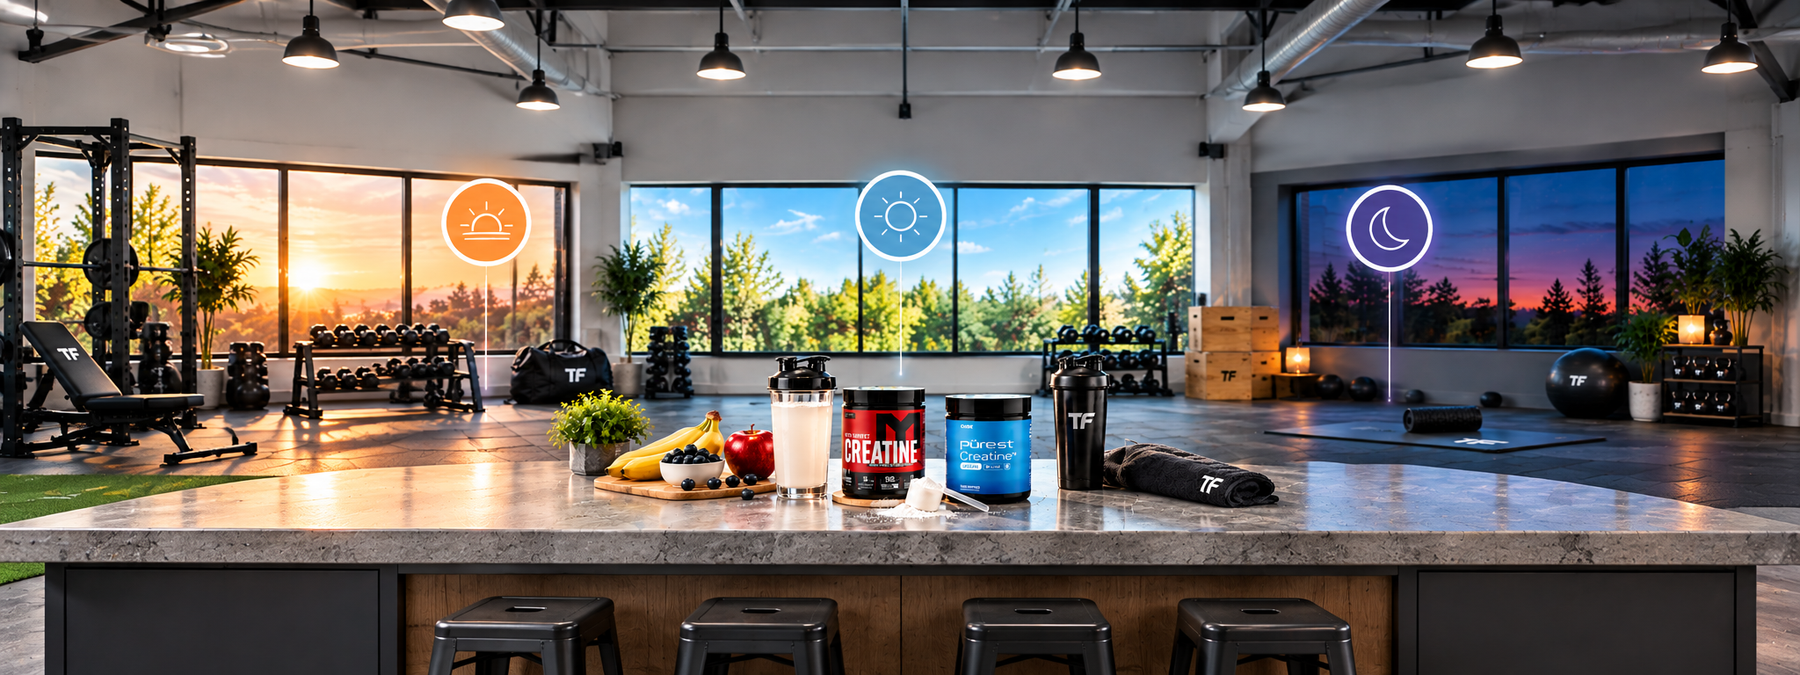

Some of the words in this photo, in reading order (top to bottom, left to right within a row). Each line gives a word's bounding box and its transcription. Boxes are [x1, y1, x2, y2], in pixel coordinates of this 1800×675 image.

[57, 347, 80, 361] TF
[564, 367, 587, 383] TF
[1221, 370, 1237, 382] TF
[1569, 374, 1588, 387] TF
[1068, 412, 1096, 430] TF
[844, 438, 918, 464] CREATINE
[1199, 474, 1225, 495] TF
